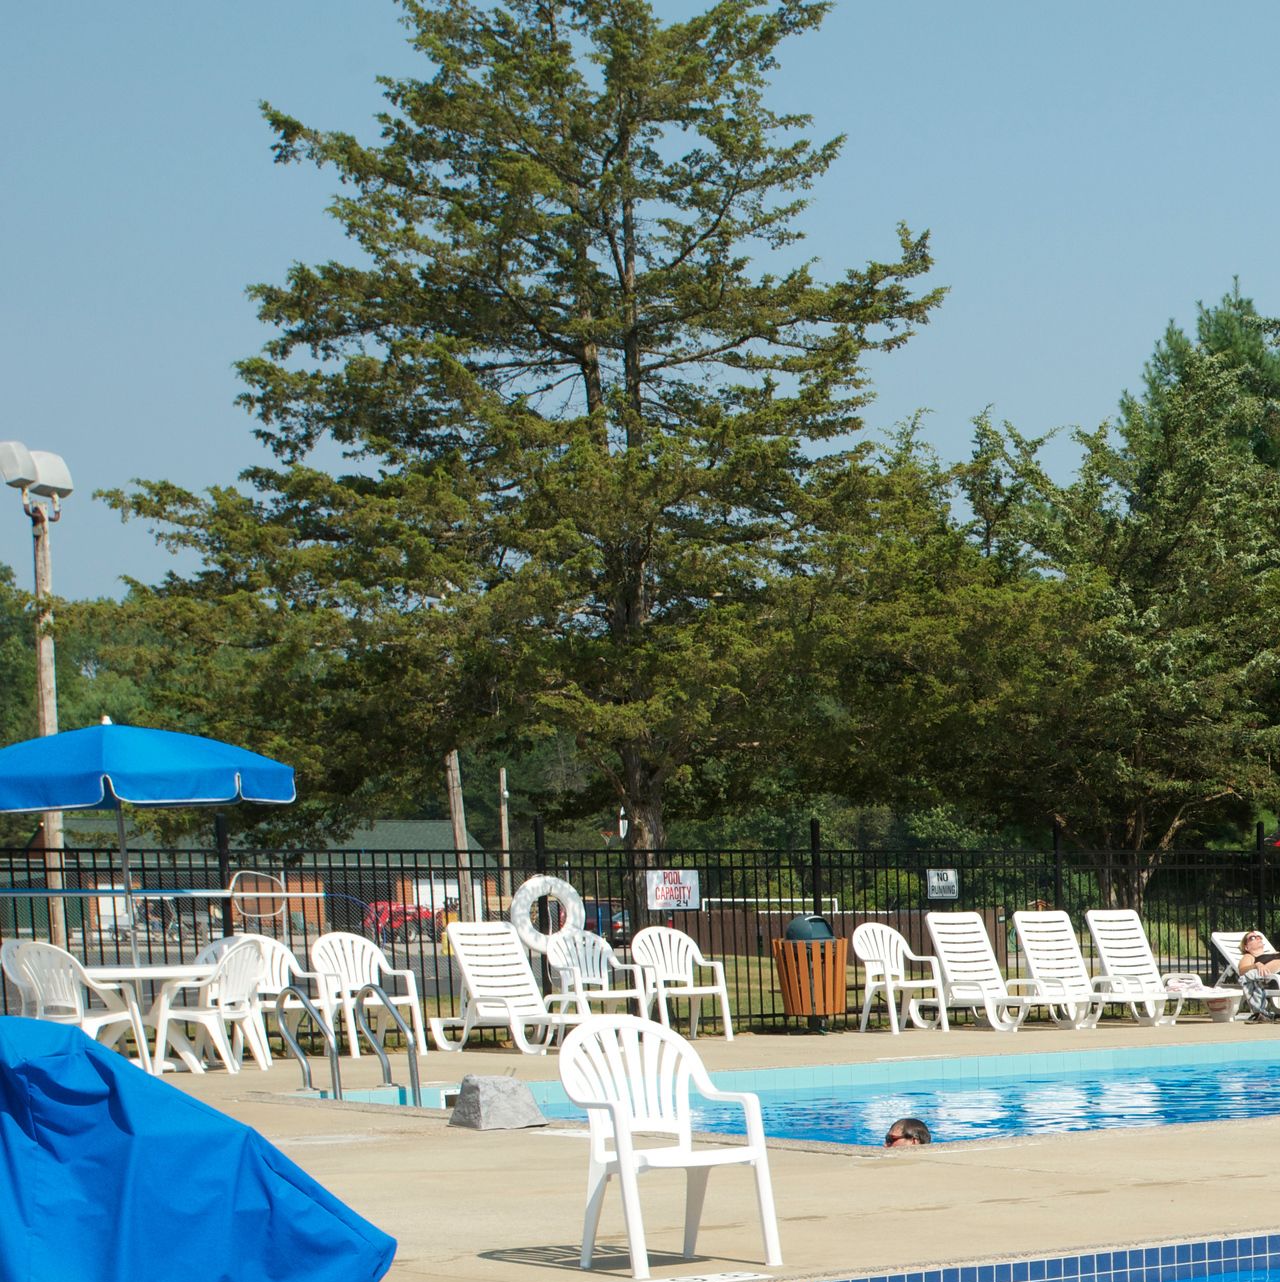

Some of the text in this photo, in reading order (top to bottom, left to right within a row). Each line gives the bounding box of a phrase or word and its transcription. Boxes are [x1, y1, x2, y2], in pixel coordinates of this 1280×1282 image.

[663, 871, 683, 885] POOL
[937, 872, 948, 881] NO
[655, 886, 691, 900] CAPACITY
[676, 899, 689, 907] 24
